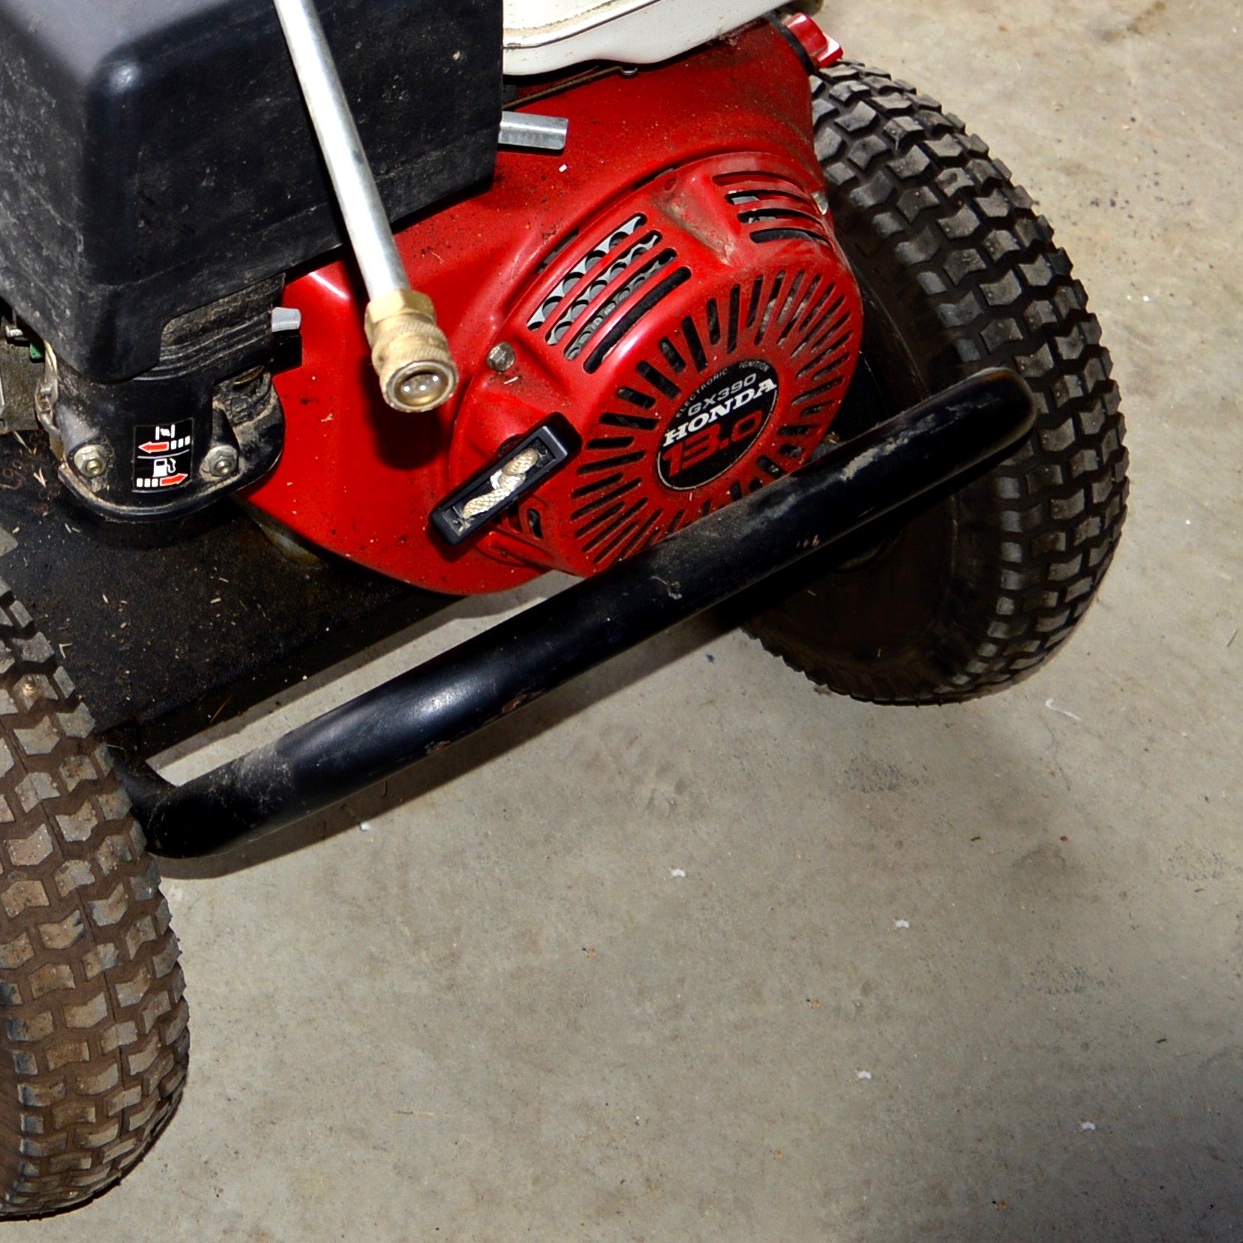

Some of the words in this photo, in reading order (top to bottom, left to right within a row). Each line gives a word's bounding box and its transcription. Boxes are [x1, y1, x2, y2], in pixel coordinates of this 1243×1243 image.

[663, 378, 777, 447] HONDA
[676, 367, 728, 418] ELECTRONIC
[687, 373, 757, 417] GX390
[662, 410, 763, 477] 13.0
